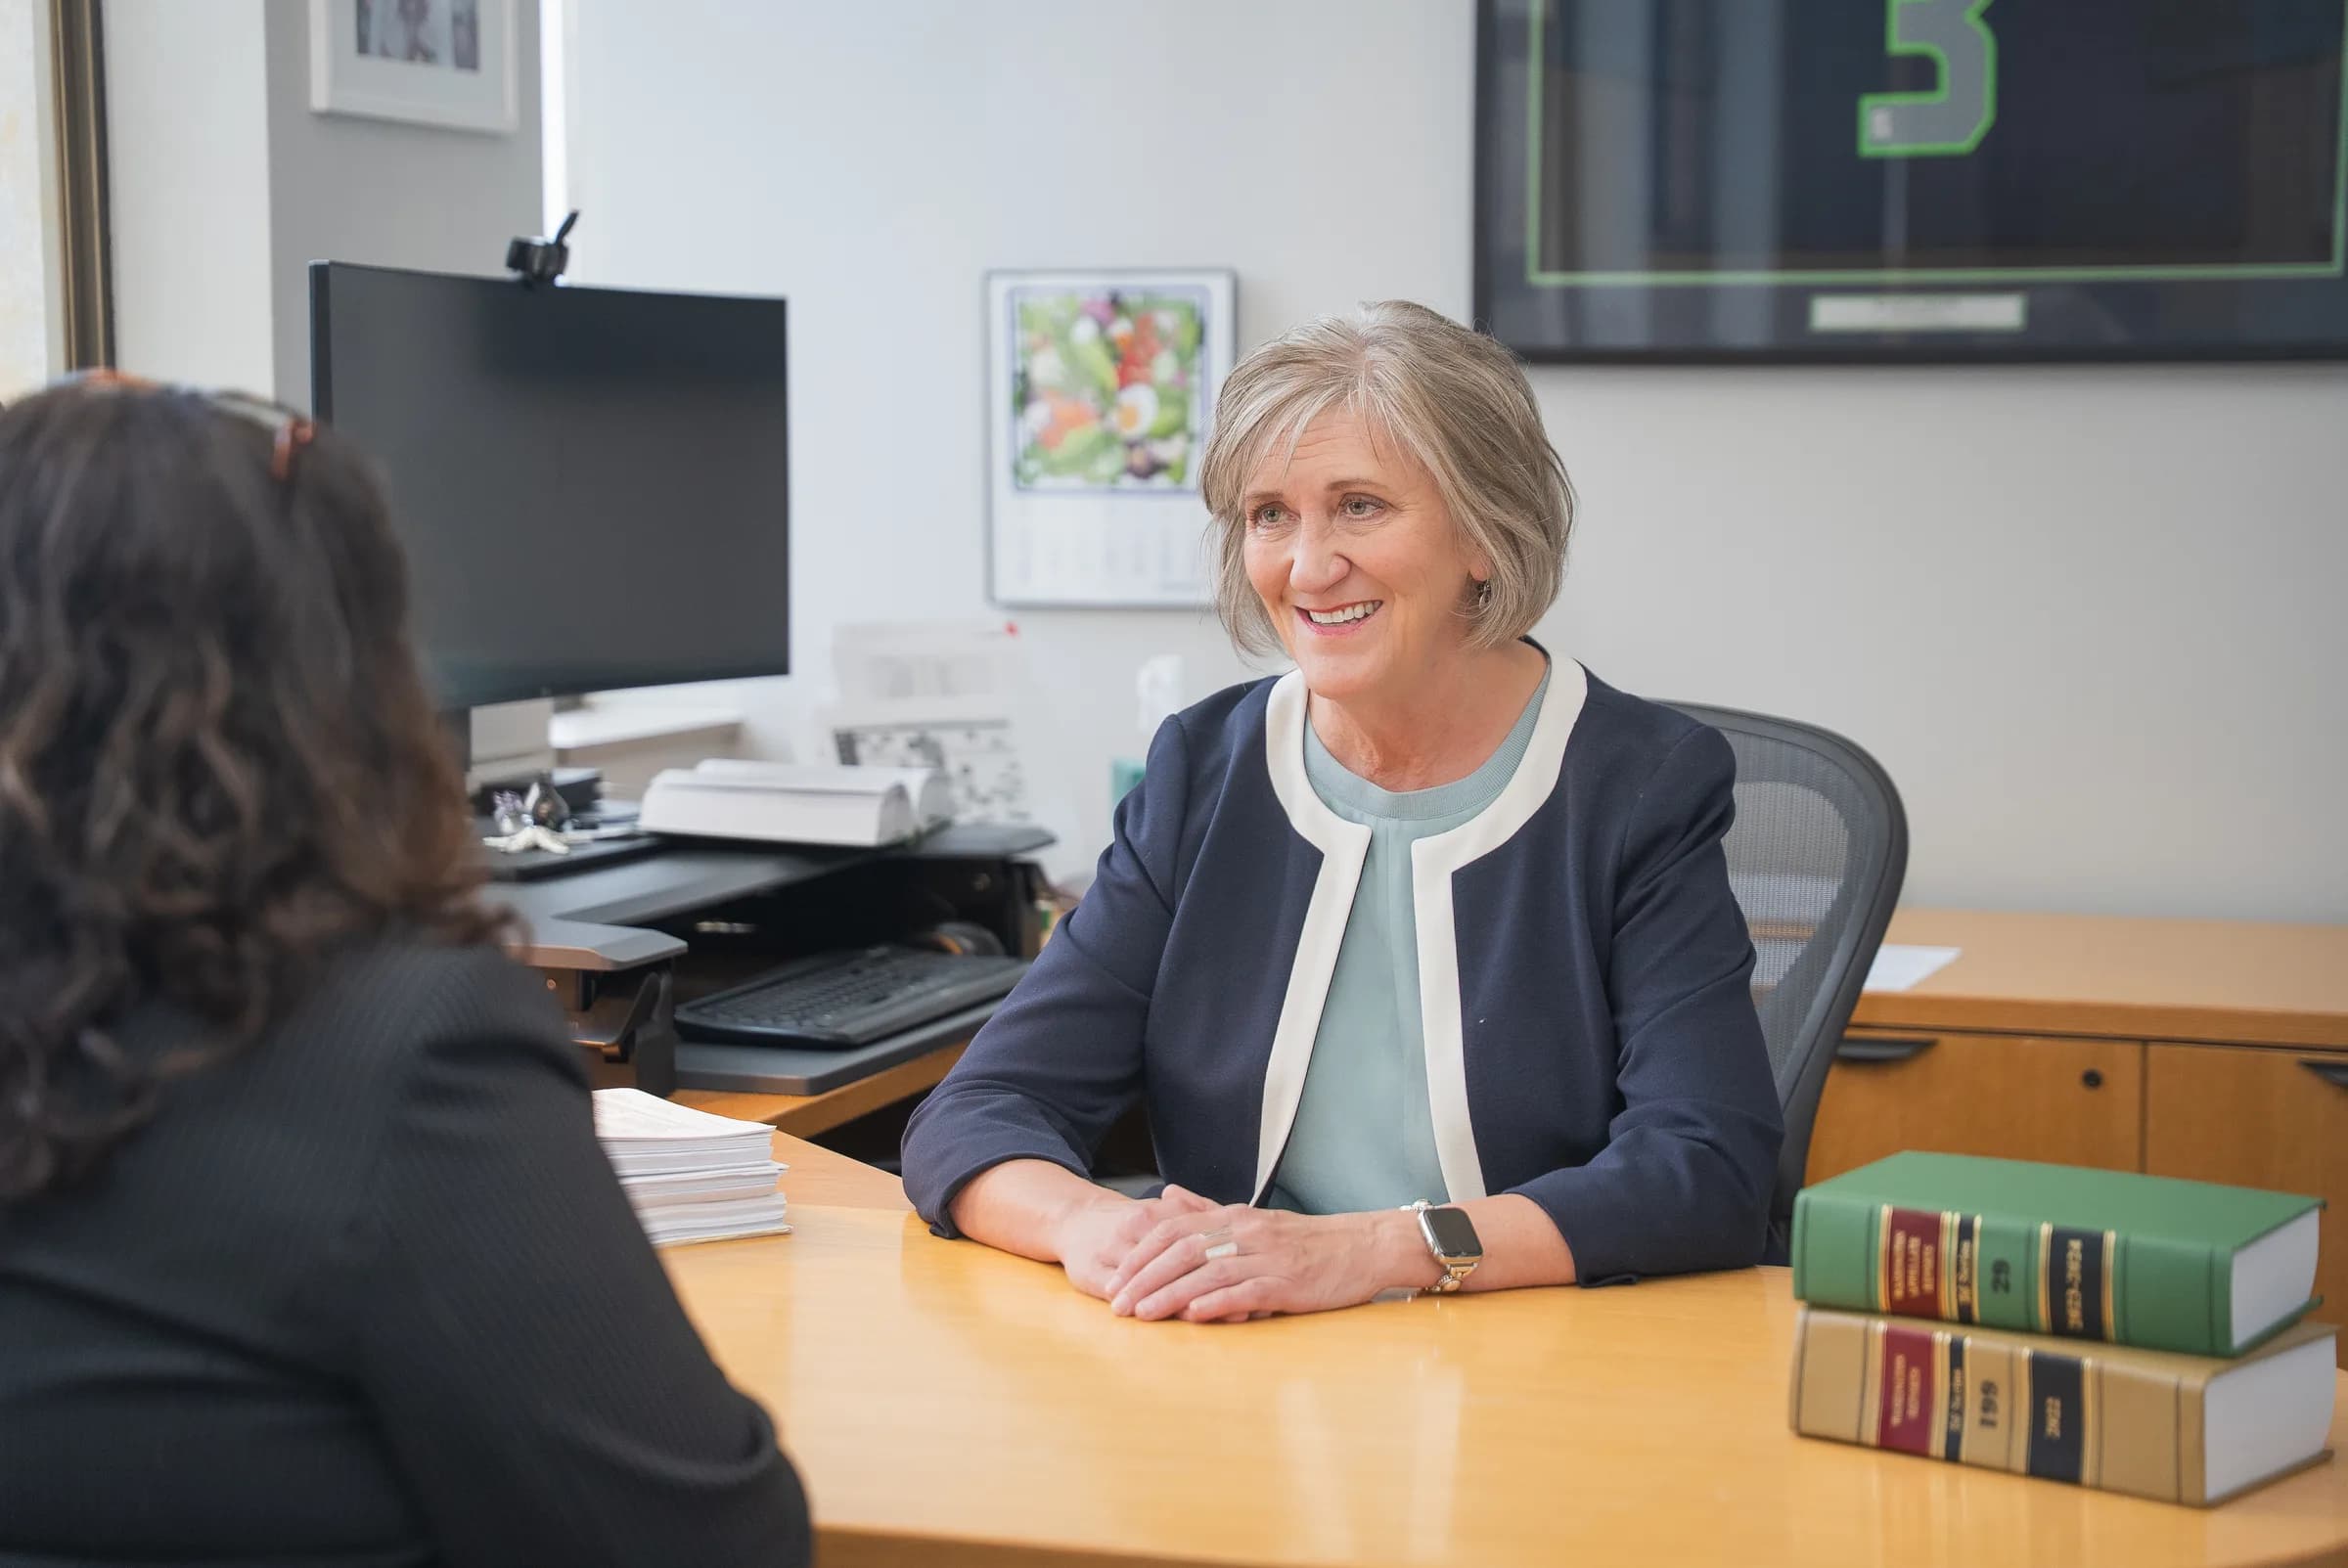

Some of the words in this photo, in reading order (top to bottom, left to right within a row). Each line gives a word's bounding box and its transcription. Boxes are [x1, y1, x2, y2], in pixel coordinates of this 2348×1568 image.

[1857, 0, 1997, 157] 3
[1991, 1258, 2010, 1294] 29
[1979, 1379, 1999, 1427] 199
